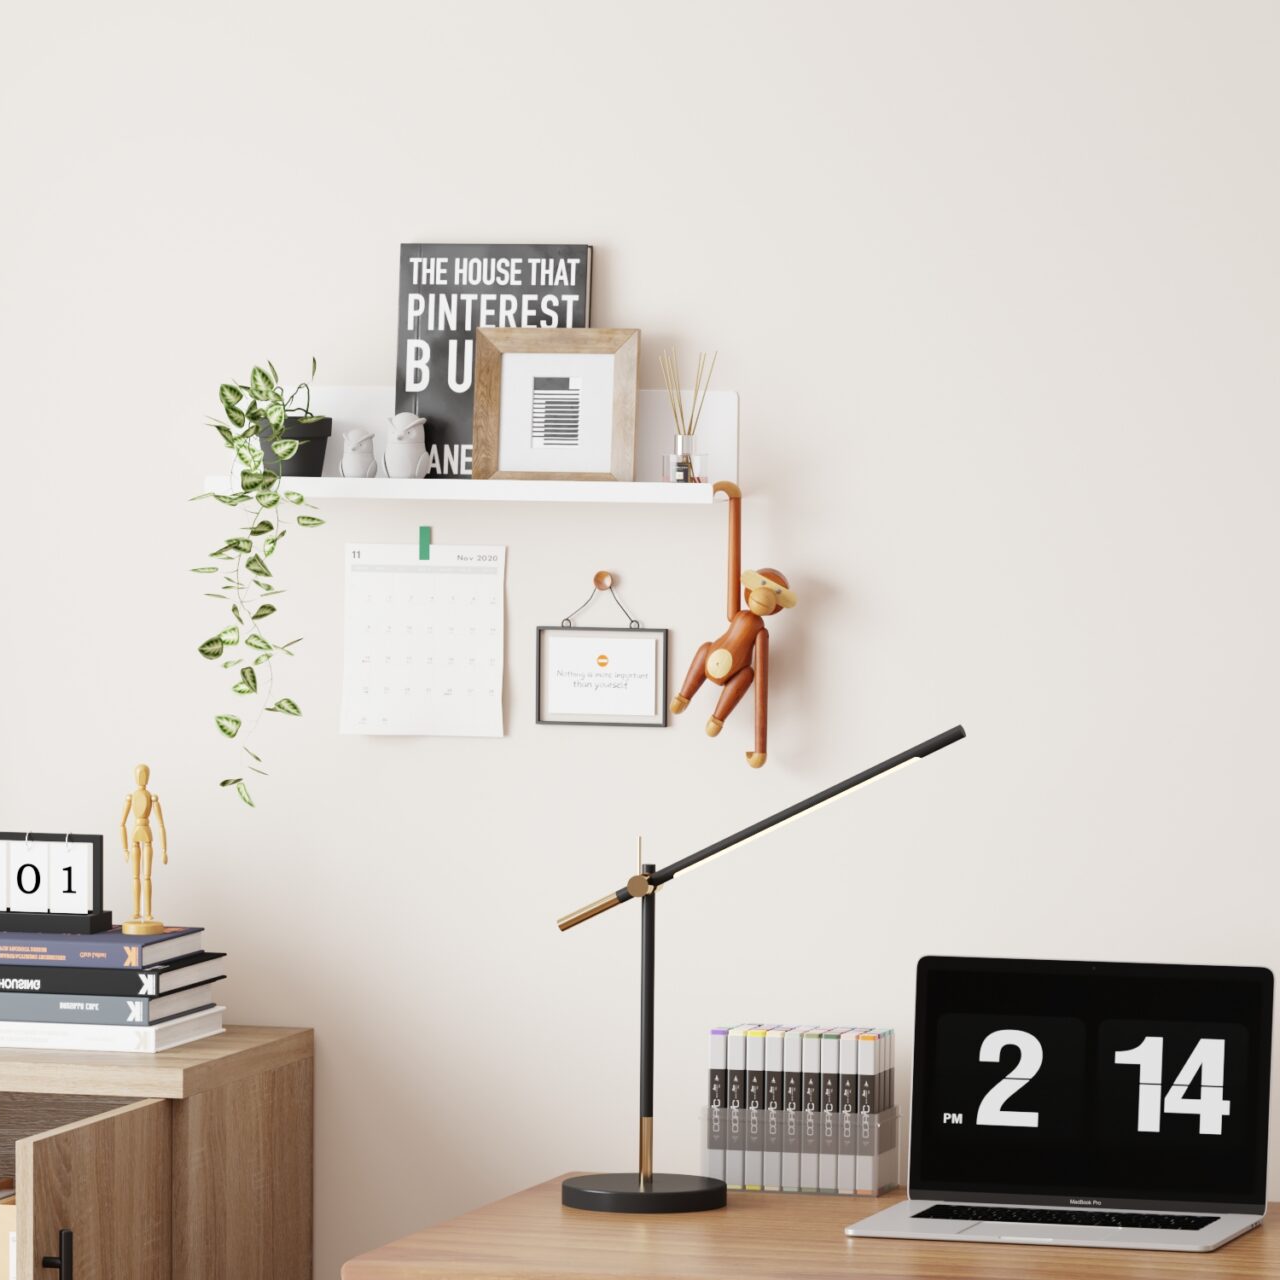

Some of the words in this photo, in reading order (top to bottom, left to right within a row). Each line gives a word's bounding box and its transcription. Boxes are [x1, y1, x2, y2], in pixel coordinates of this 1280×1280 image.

[409, 257, 448, 286] THE
[454, 258, 523, 286] HOUSE
[528, 258, 581, 286] THAT
[407, 293, 580, 331] PINTEREST
[351, 551, 362, 559] 11
[456, 554, 474, 562] Nov
[975, 1029, 1044, 1128] 2
[1114, 1035, 1231, 1136] 14
[943, 1113, 963, 1124] PM
